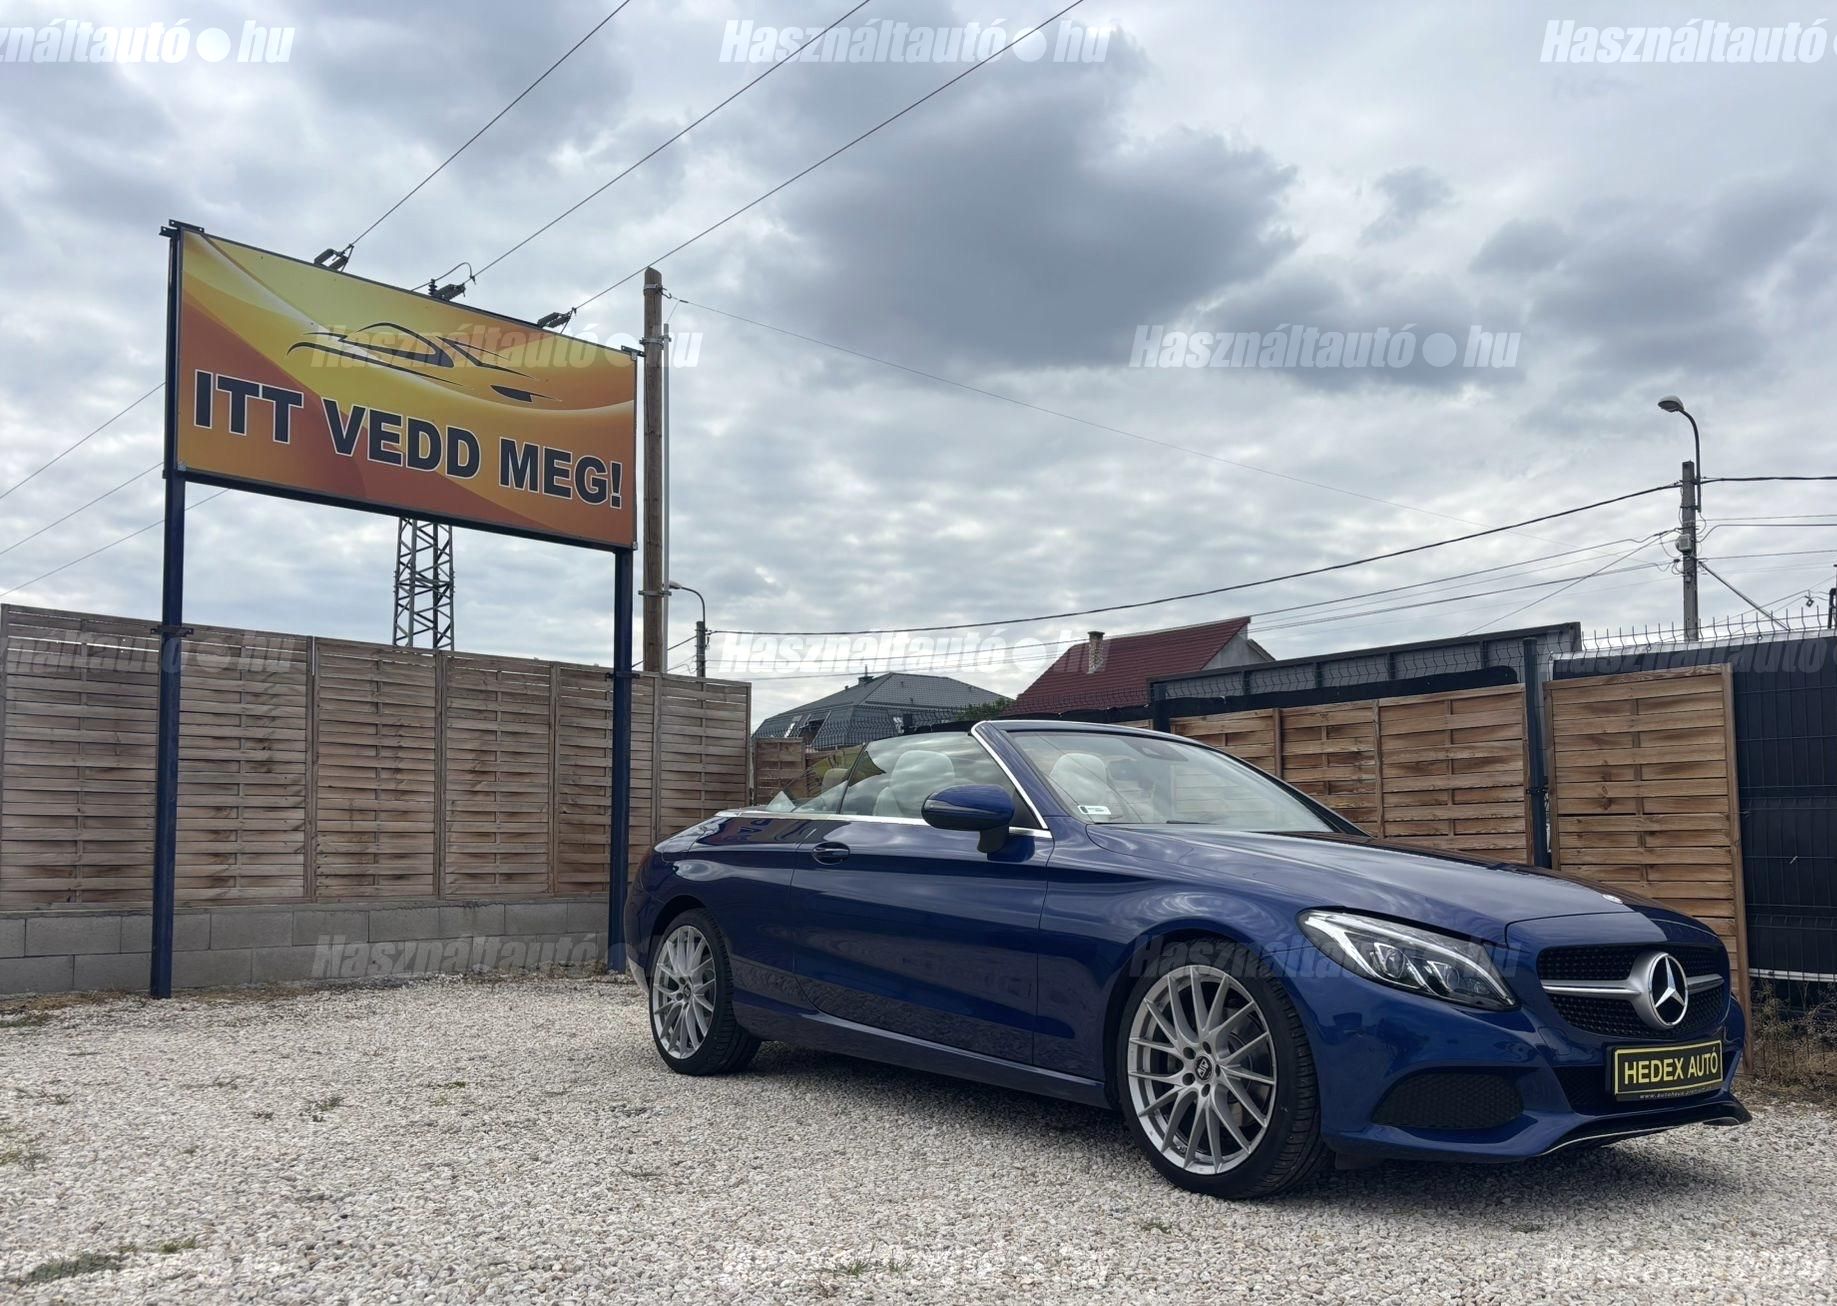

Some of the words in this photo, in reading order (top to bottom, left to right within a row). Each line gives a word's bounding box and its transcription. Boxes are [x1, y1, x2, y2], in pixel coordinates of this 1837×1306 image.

[193, 369, 304, 444] ITT
[321, 397, 481, 479] VEDD
[499, 436, 624, 509] MEG!
[1624, 1057, 1684, 1085] HEDEX
[1688, 1047, 1719, 1079] AUTÓ
